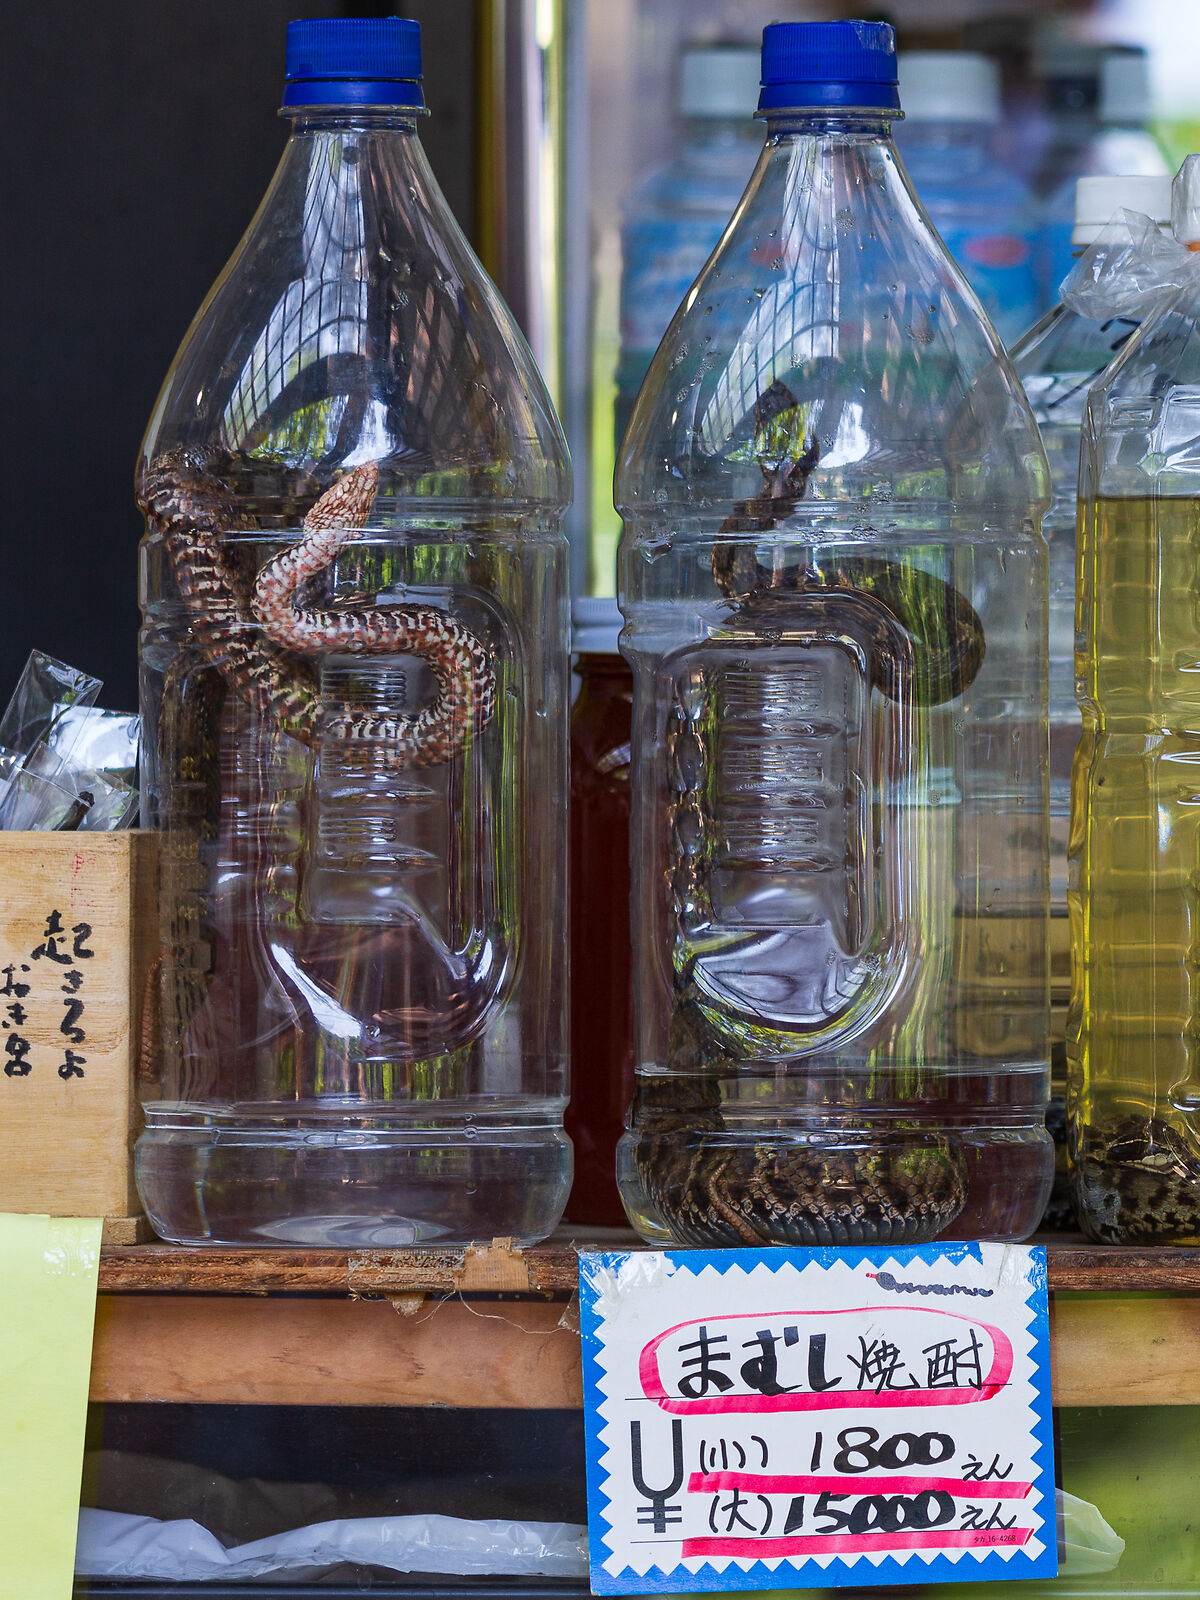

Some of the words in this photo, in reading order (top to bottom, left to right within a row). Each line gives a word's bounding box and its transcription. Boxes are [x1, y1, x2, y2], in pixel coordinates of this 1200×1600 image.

[677, 1325, 984, 1397] まむし焼酎
[988, 1534, 1017, 1543] 16-4268
